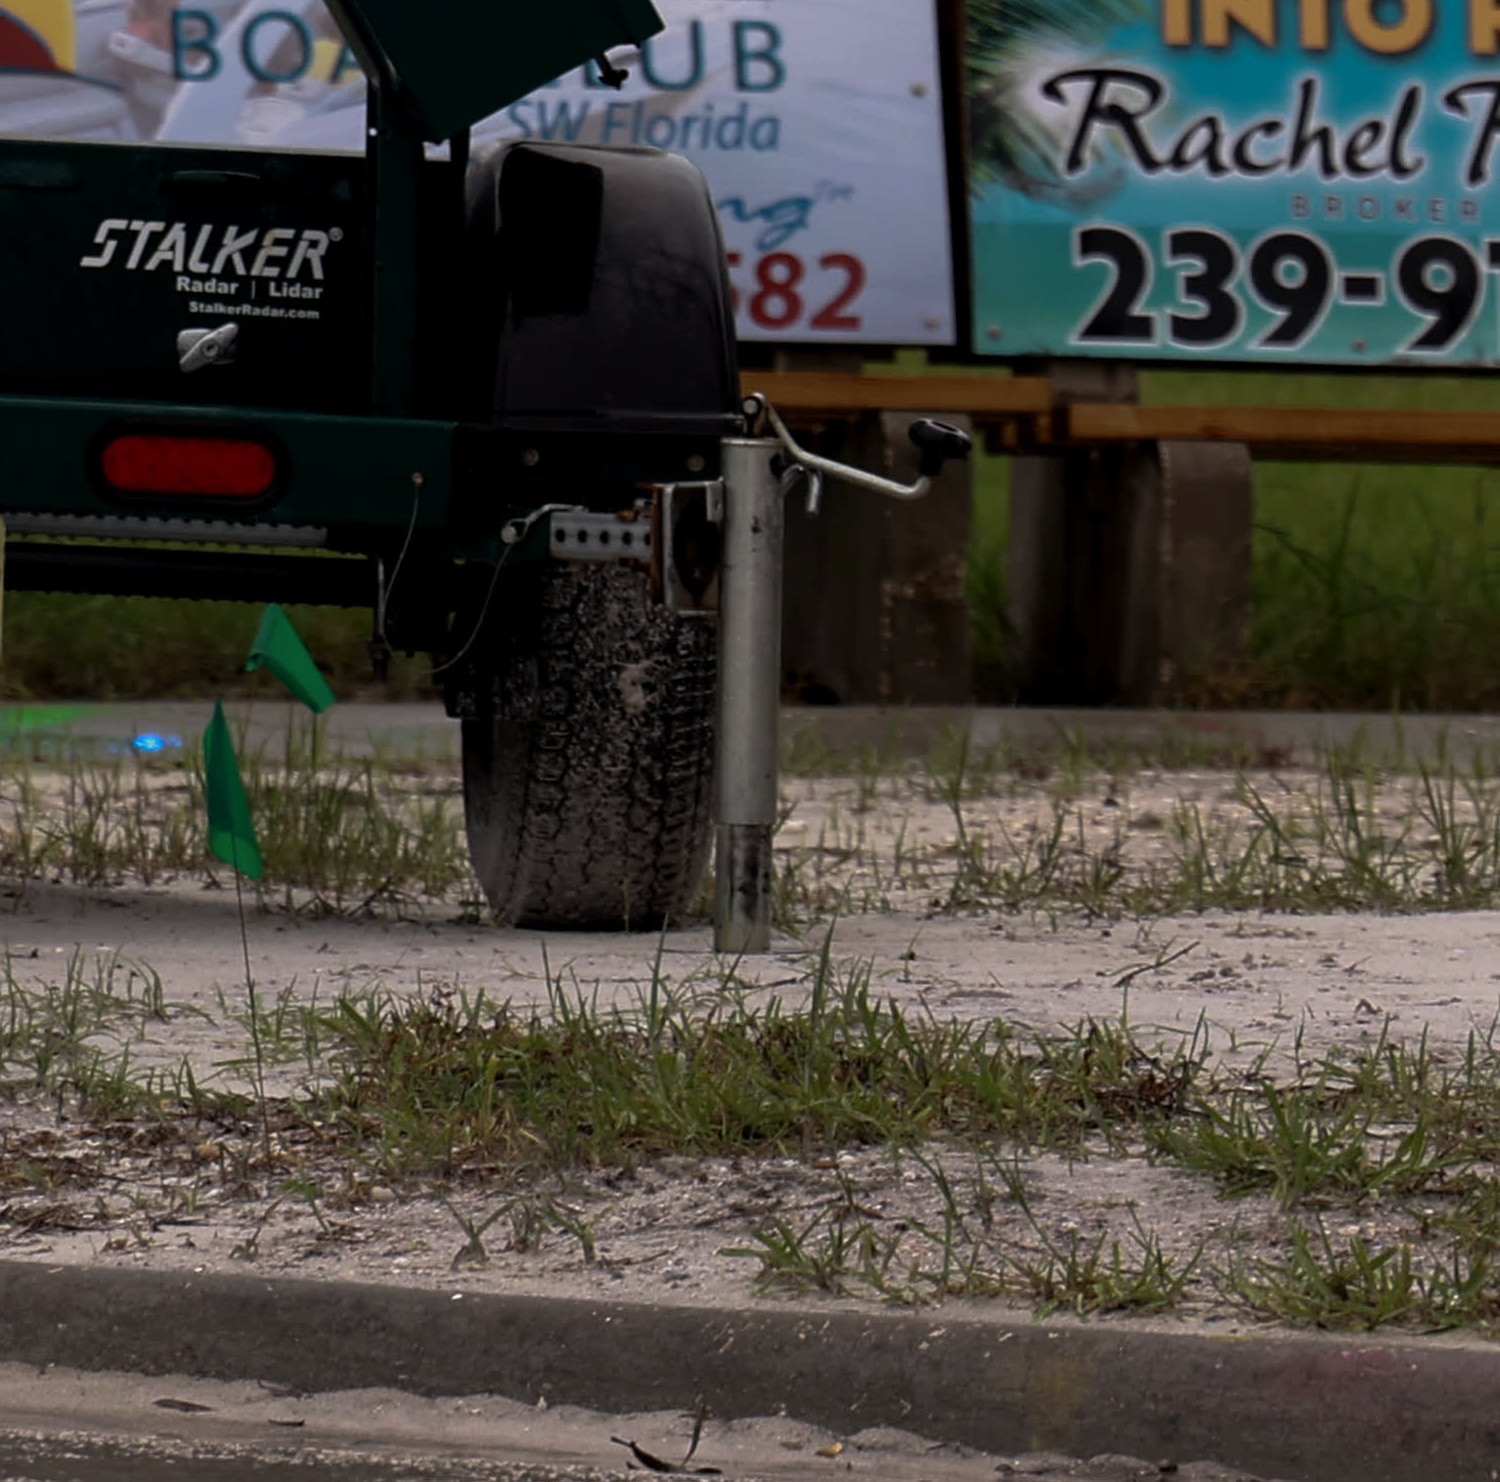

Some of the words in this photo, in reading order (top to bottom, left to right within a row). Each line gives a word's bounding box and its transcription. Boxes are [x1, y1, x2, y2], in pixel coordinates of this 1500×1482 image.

[506, 98, 591, 142] SW
[603, 101, 781, 152] Florida
[1041, 66, 1425, 180] Rachel
[1289, 193, 1481, 224] BROKER
[175, 274, 240, 296] Radar
[268, 281, 324, 300] Lidar
[1072, 226, 1500, 354] 239-9
[188, 300, 321, 321] StalkerRadar.com
